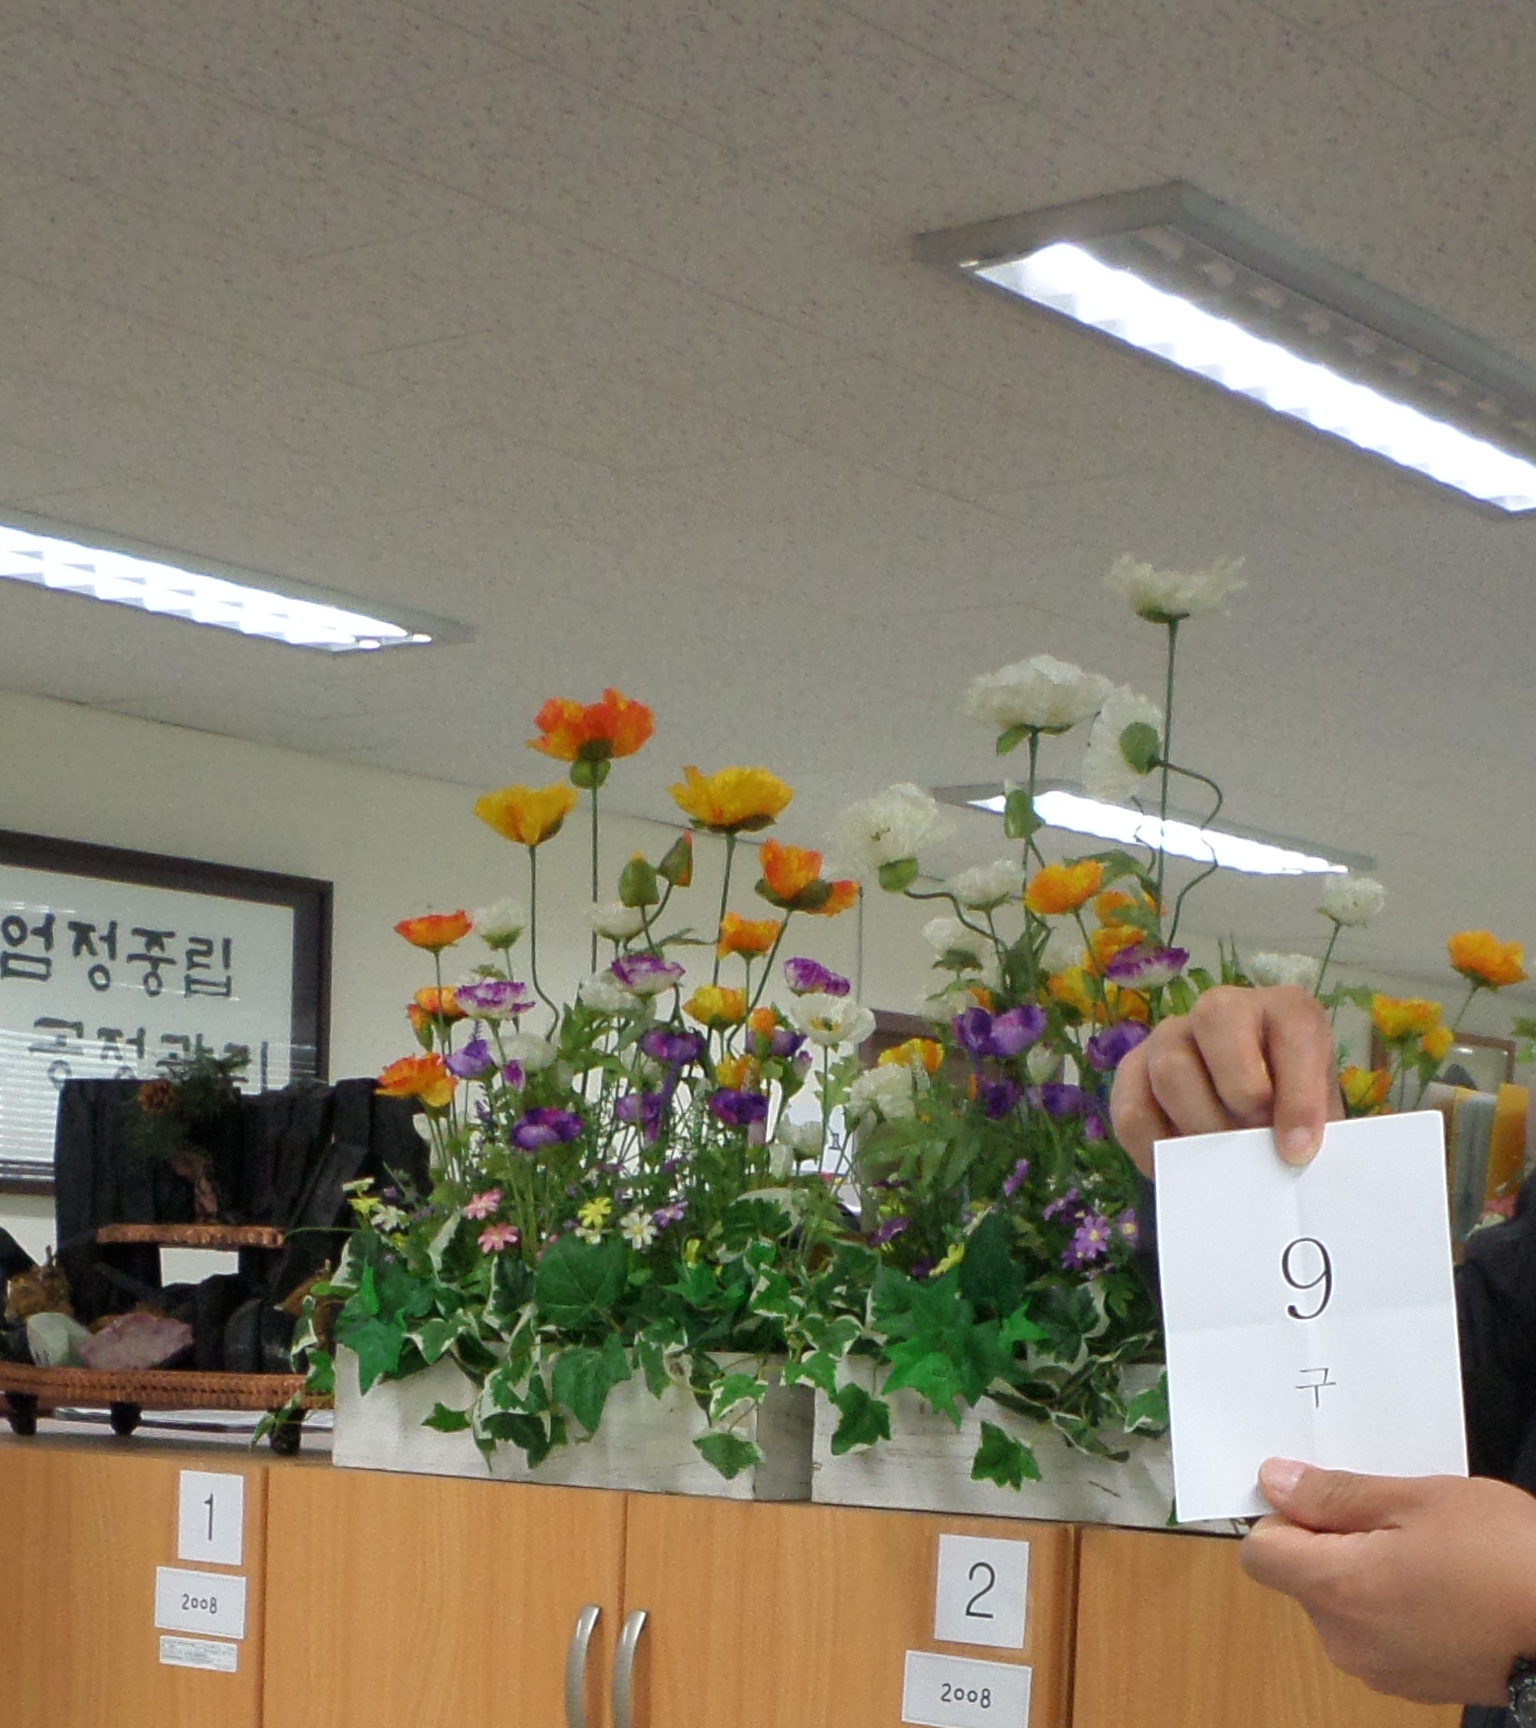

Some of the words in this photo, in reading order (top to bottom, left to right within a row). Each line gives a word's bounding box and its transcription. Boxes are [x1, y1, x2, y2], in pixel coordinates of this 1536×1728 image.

[0, 913, 233, 998] 엄정중립
[1281, 1237, 1333, 1320] 9
[1295, 1367, 1337, 1408] 구
[204, 1493, 214, 1541] 1
[182, 1593, 217, 1614] 2008
[965, 1562, 995, 1619] 2
[940, 1682, 991, 1709] 2008
